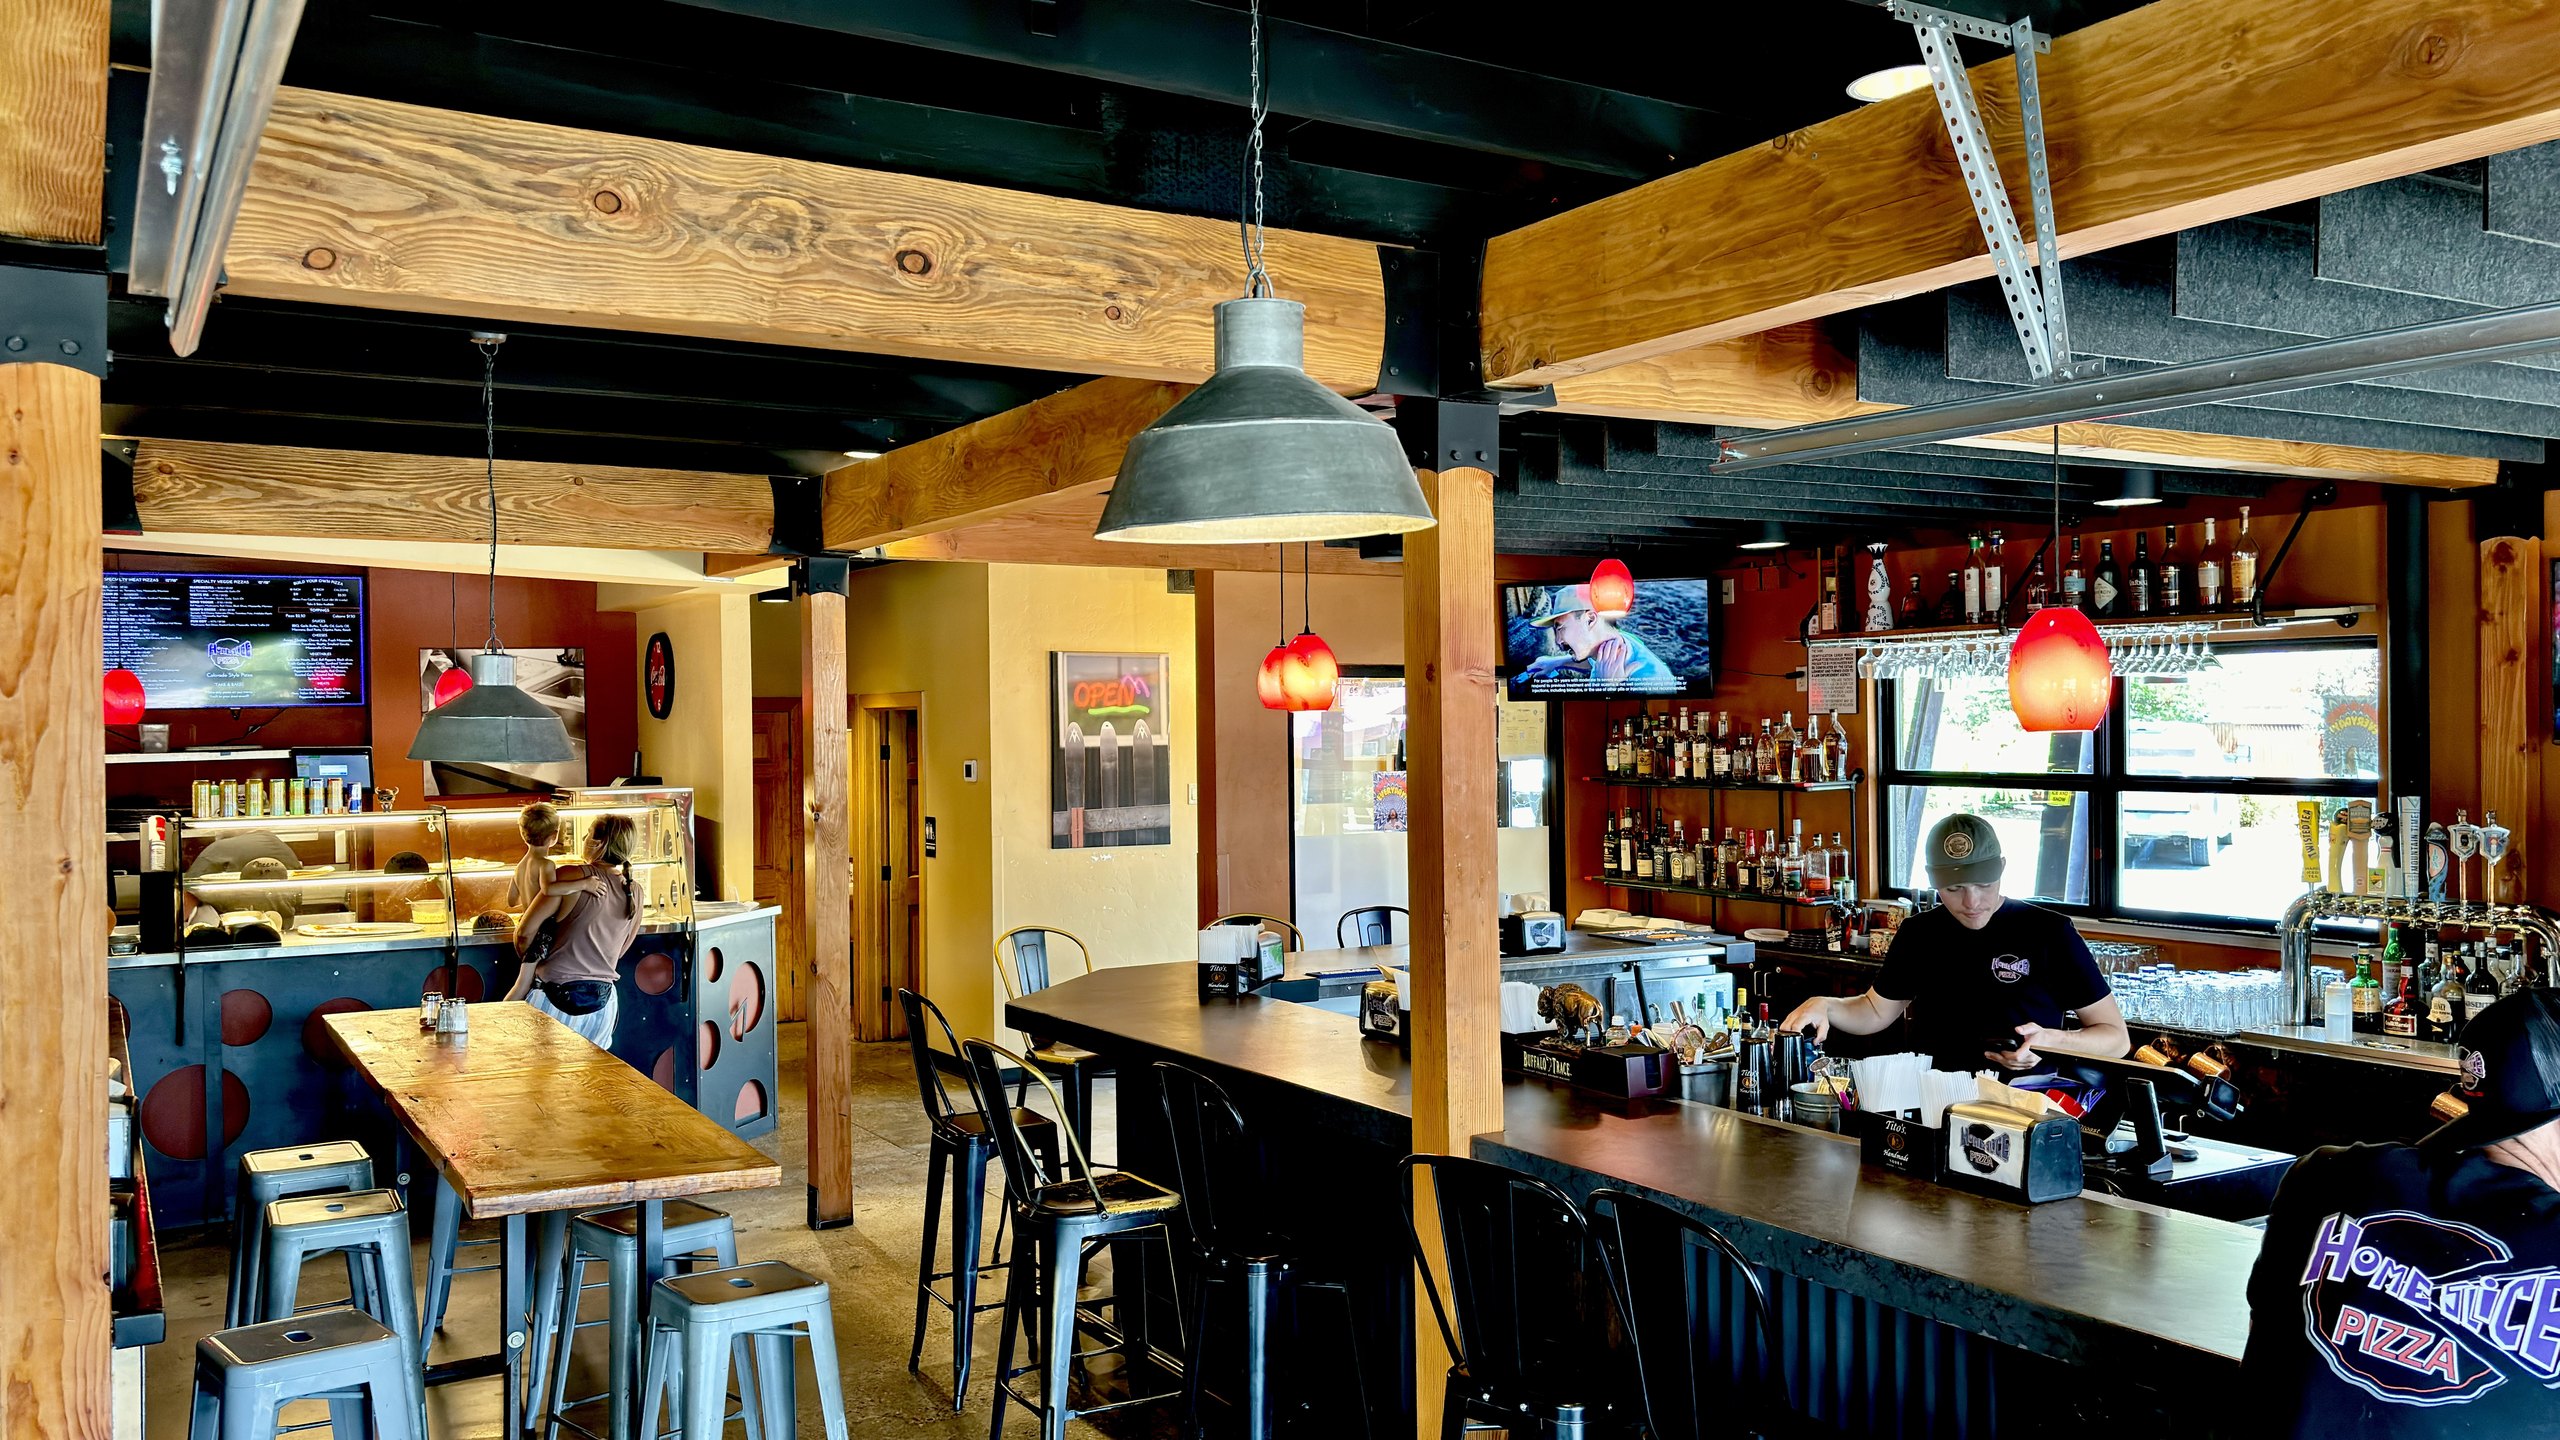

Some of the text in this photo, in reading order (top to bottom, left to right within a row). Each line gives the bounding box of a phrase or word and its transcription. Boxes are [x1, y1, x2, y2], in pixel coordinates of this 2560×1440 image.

[1073, 680, 1136, 708] OPEN
[2301, 809, 2317, 859] TWISTED TEA
[2410, 812, 2420, 872] MOUNTAIN TIME
[1523, 1050, 1572, 1077] BUFFALO TRACE
[1969, 1150, 1994, 1168] PIZZA
[2331, 1304, 2460, 1385] PIZZA
